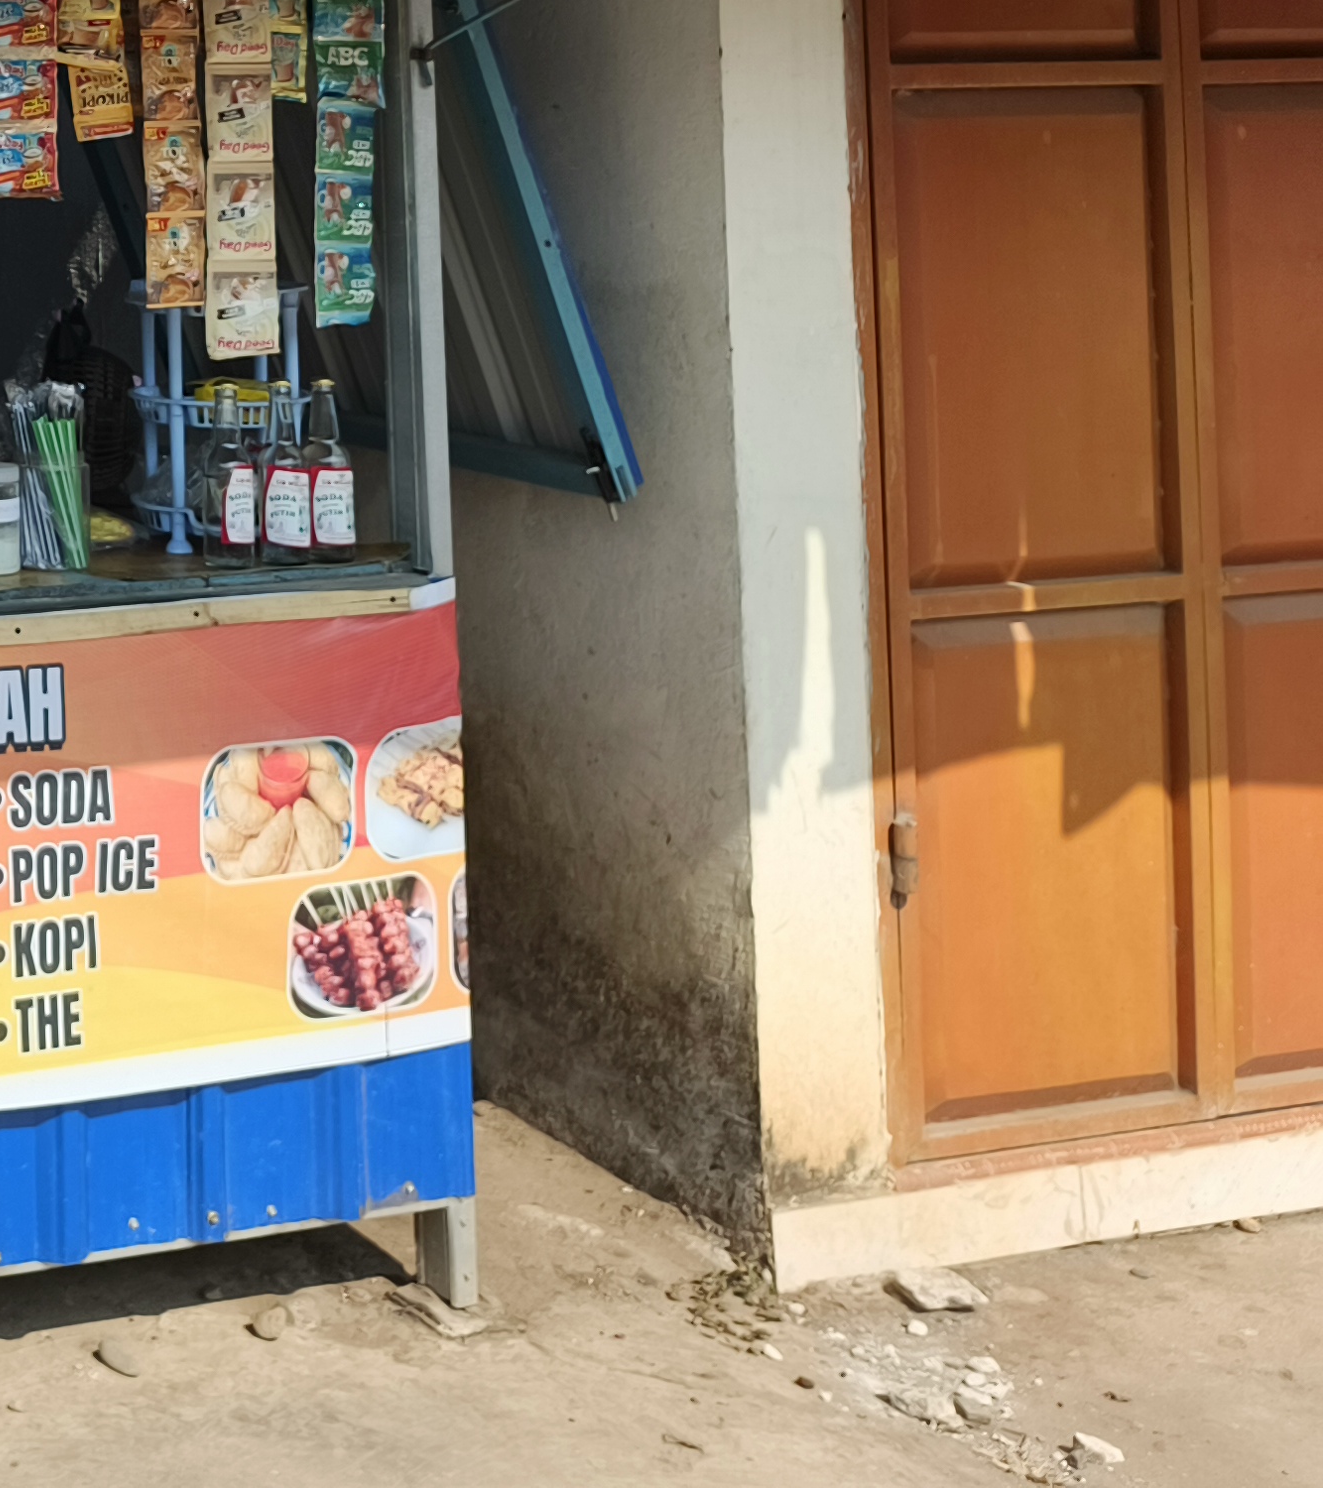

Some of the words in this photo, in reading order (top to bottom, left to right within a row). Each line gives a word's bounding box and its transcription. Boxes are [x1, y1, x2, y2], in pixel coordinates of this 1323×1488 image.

[217, 41, 238, 55] Day
[240, 43, 267, 55] Good
[327, 47, 368, 66] ABC
[220, 139, 240, 153] Day
[243, 141, 269, 153] Good
[219, 238, 241, 252] Day
[244, 240, 271, 251] Good
[218, 338, 242, 350] Day
[244, 339, 274, 349] Good
[8, 768, 113, 828] SODA
[11, 845, 85, 904] POP
[96, 838, 157, 894] ICE
[13, 915, 98, 978] KOPI
[14, 991, 82, 1053] THE
